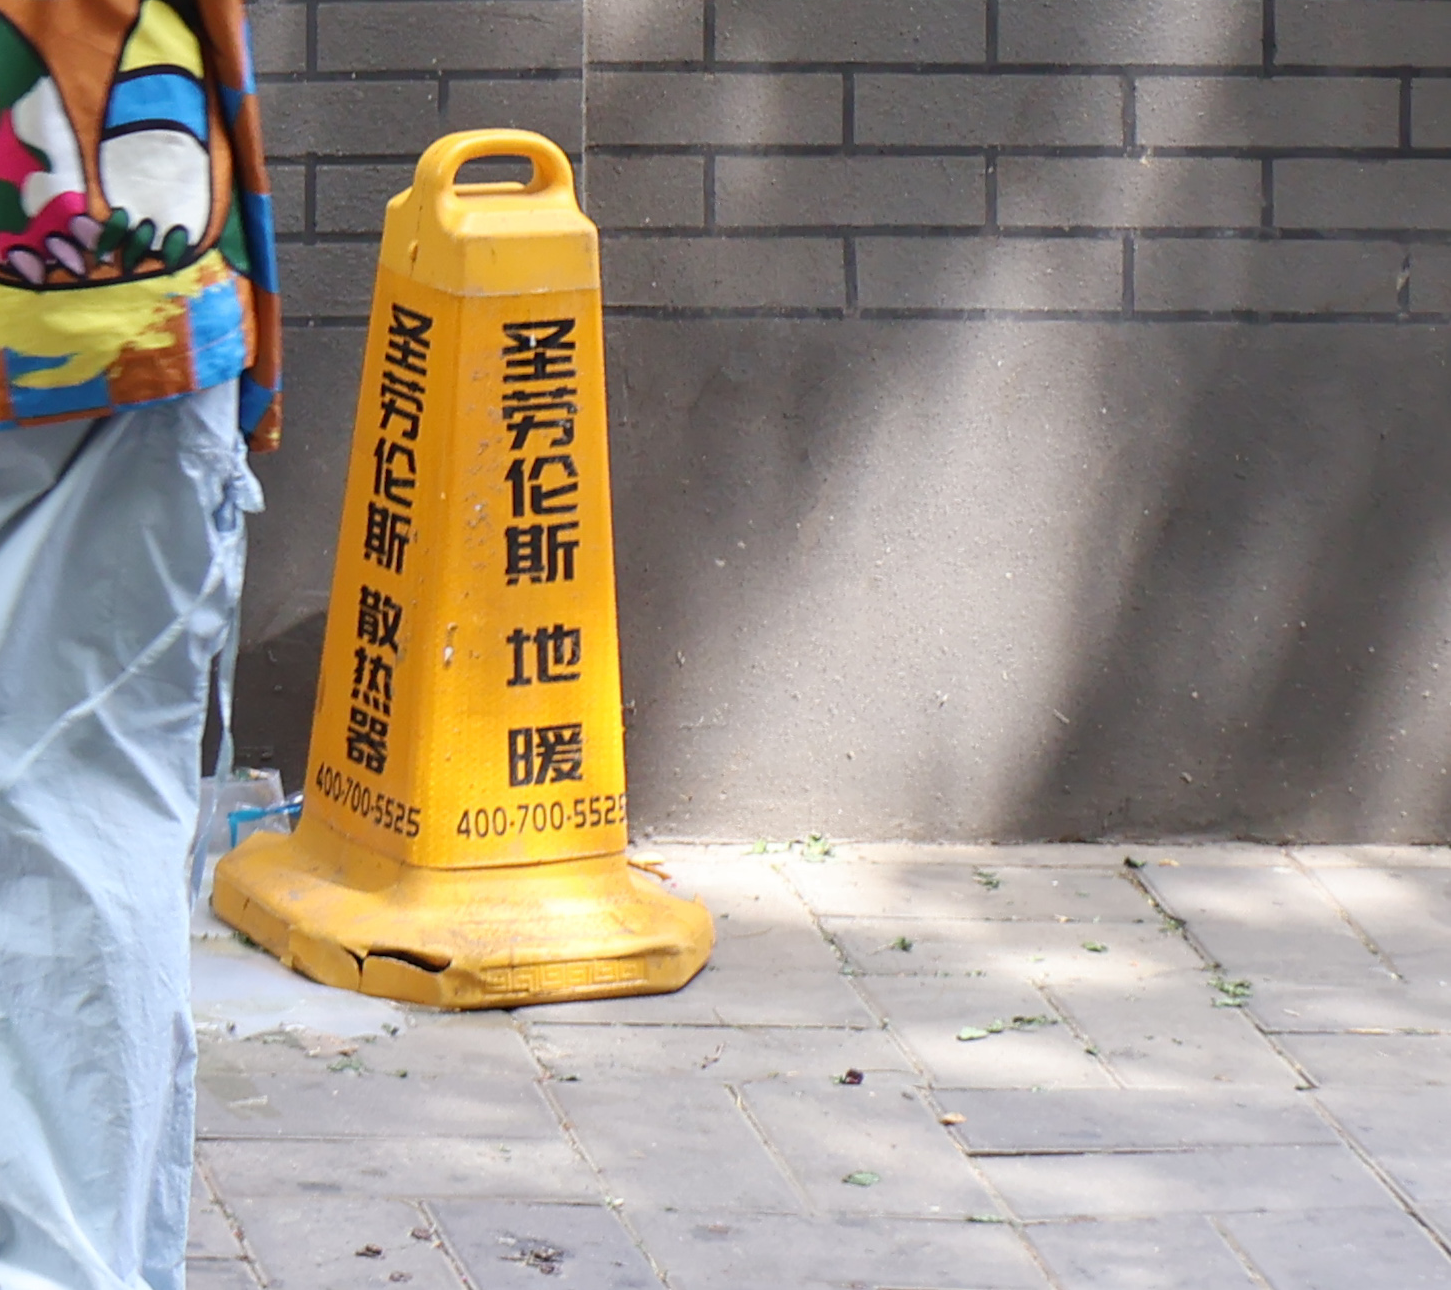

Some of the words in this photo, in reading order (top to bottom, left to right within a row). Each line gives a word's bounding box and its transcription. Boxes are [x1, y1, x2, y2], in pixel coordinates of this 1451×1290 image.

[364, 303, 433, 574] 圣劳伦斯
[502, 317, 580, 586] 圣劳伦斯
[345, 585, 401, 775] 散热器
[505, 624, 583, 788] 地暖
